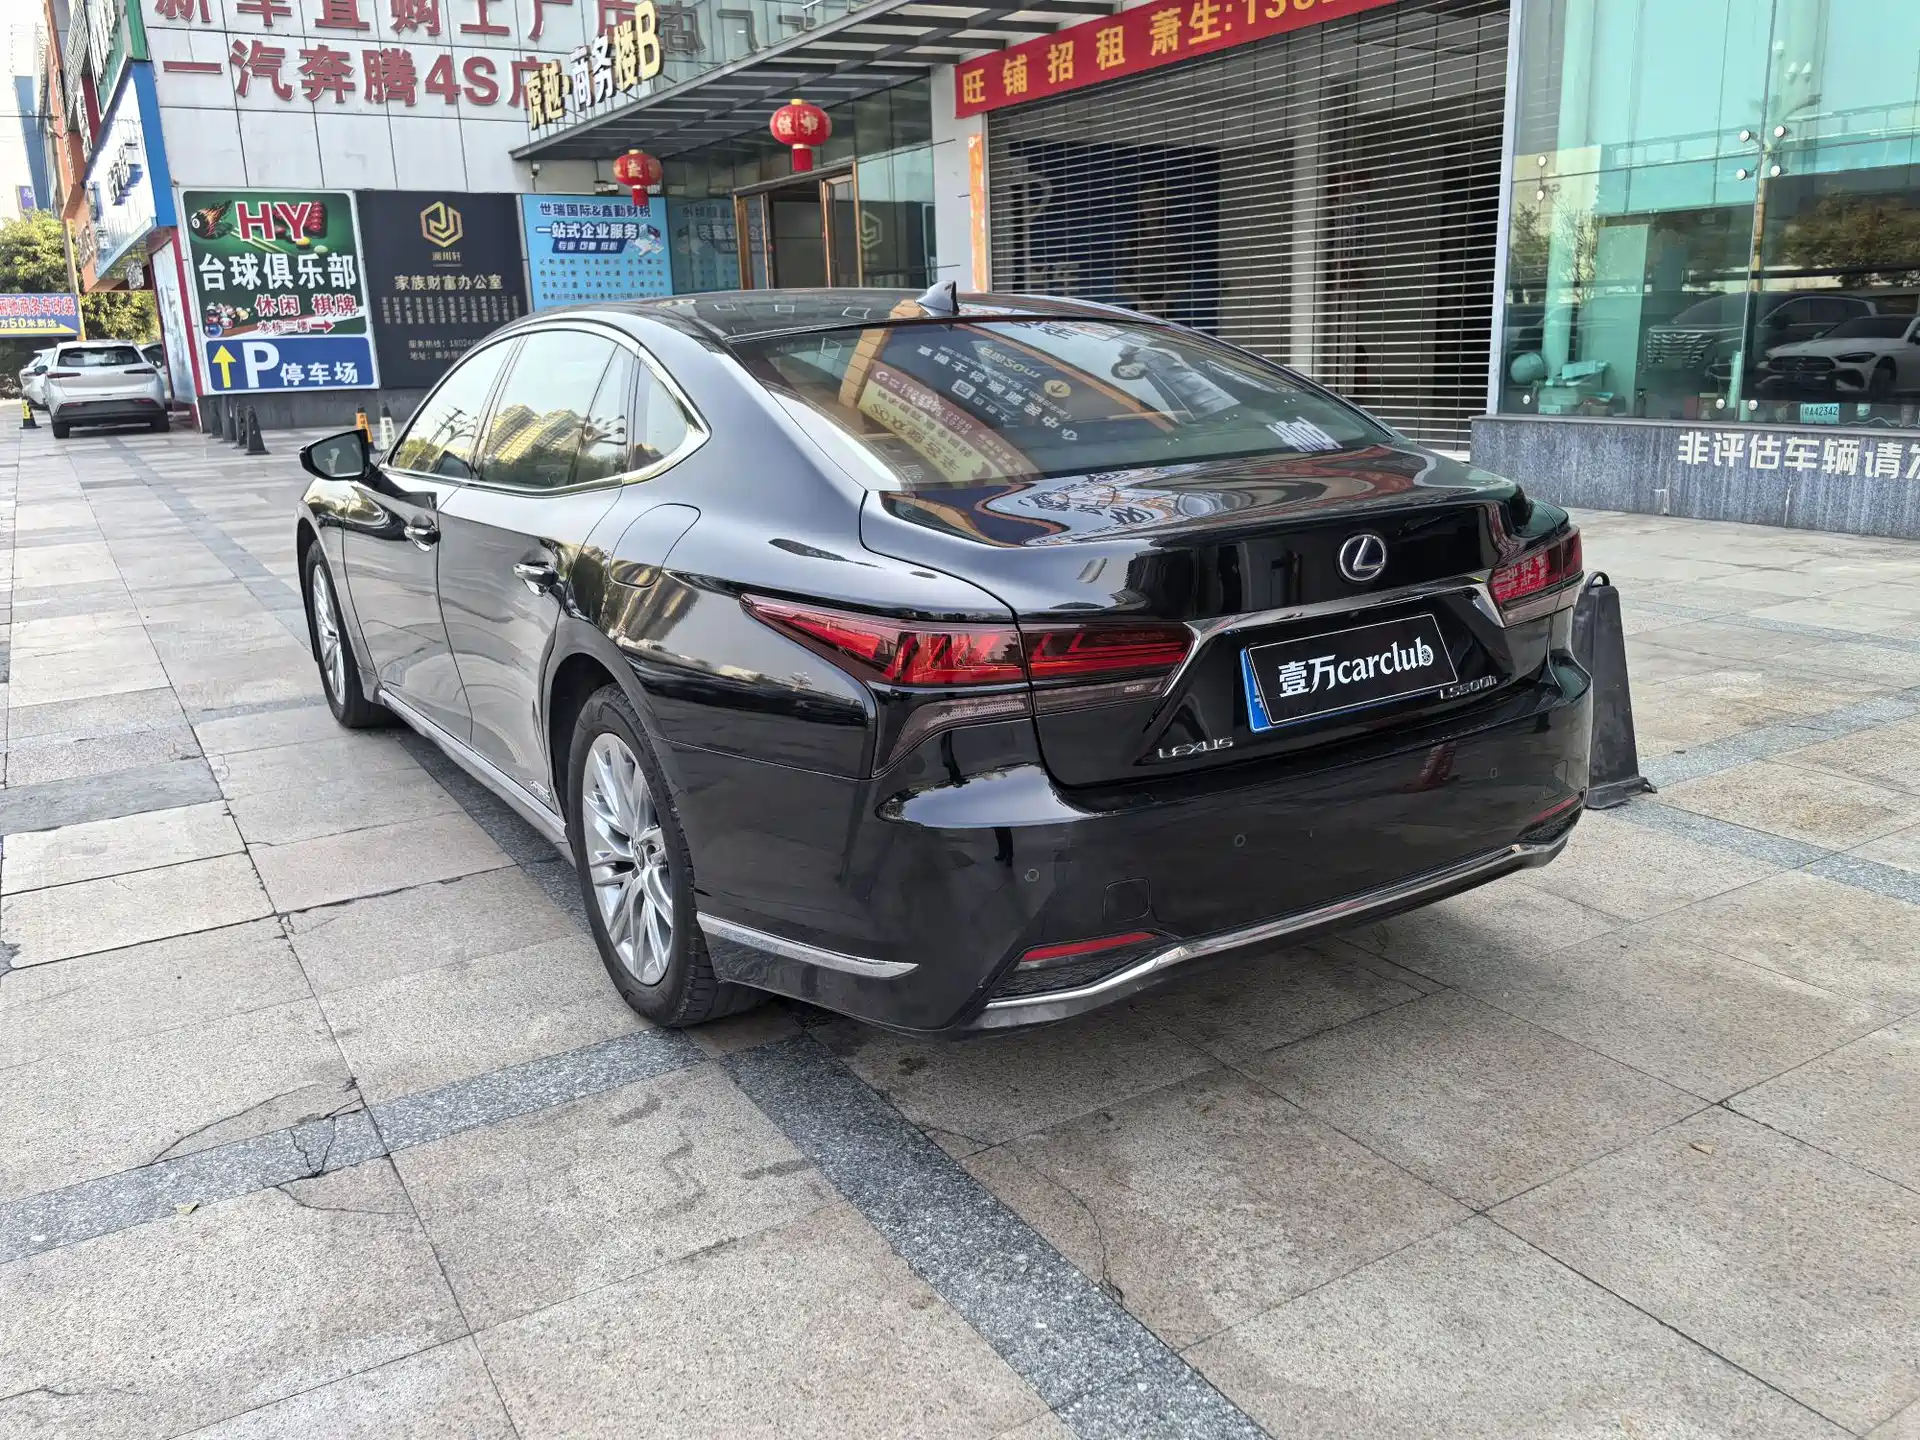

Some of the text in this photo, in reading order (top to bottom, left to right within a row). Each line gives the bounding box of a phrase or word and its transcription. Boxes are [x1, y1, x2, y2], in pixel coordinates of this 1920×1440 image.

[962, 26, 1126, 104] 旺铺招租
[235, 201, 312, 241] HY
[536, 222, 639, 239] 一站式企业服务
[198, 252, 357, 290] 台球俱乐部
[394, 274, 503, 291] 家族财富办公室
[255, 294, 301, 316] 休闲
[311, 294, 359, 316] 棋牌
[242, 341, 280, 389] P
[280, 361, 359, 386] 停车场
[1158, 737, 1234, 759] LEXUS
